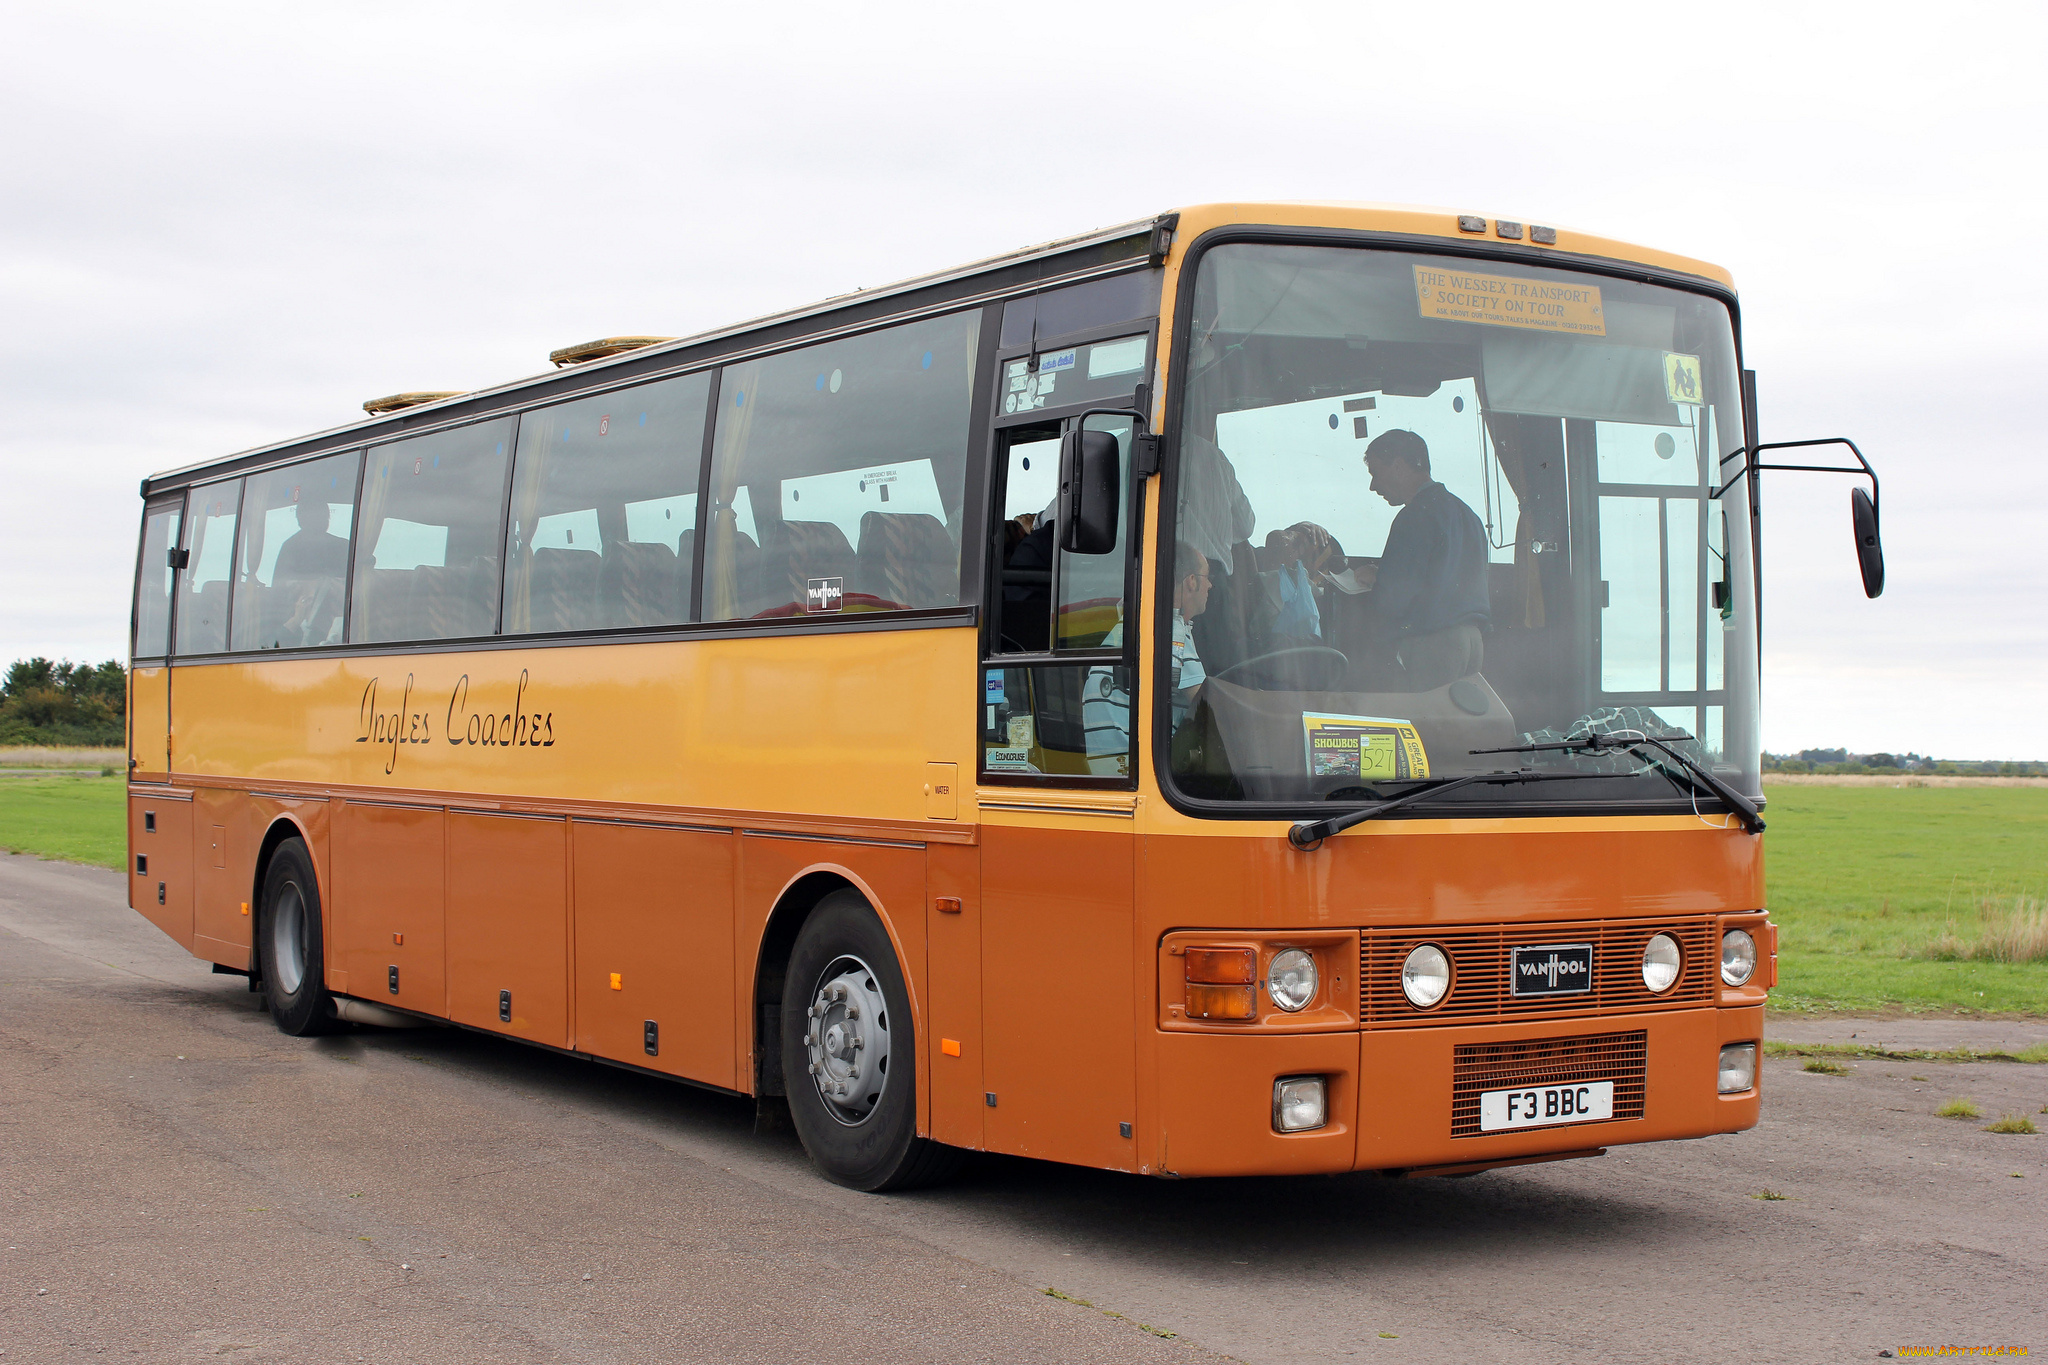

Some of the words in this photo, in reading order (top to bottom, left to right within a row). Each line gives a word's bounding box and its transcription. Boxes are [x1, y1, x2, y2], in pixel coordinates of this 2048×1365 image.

[1419, 272, 1446, 287] THE
[1450, 275, 1507, 294] WESSEX
[1511, 283, 1590, 303] TRANSPORT
[1437, 291, 1500, 310] SOCIETY
[1504, 299, 1524, 312] ON
[1527, 301, 1564, 317] TOUR
[1450, 309, 1469, 317] ABOUT
[1529, 318, 1558, 327] MAGAZINE
[356, 672, 432, 775] Ingles
[446, 668, 556, 747] Coaches
[1314, 738, 1359, 748] SHOWBUS
[1411, 742, 1424, 766] GREAT
[1361, 748, 1394, 772] 527
[934, 785, 950, 795] WATER
[1507, 1092, 1538, 1121] F3
[1545, 1087, 1590, 1118] BBC
